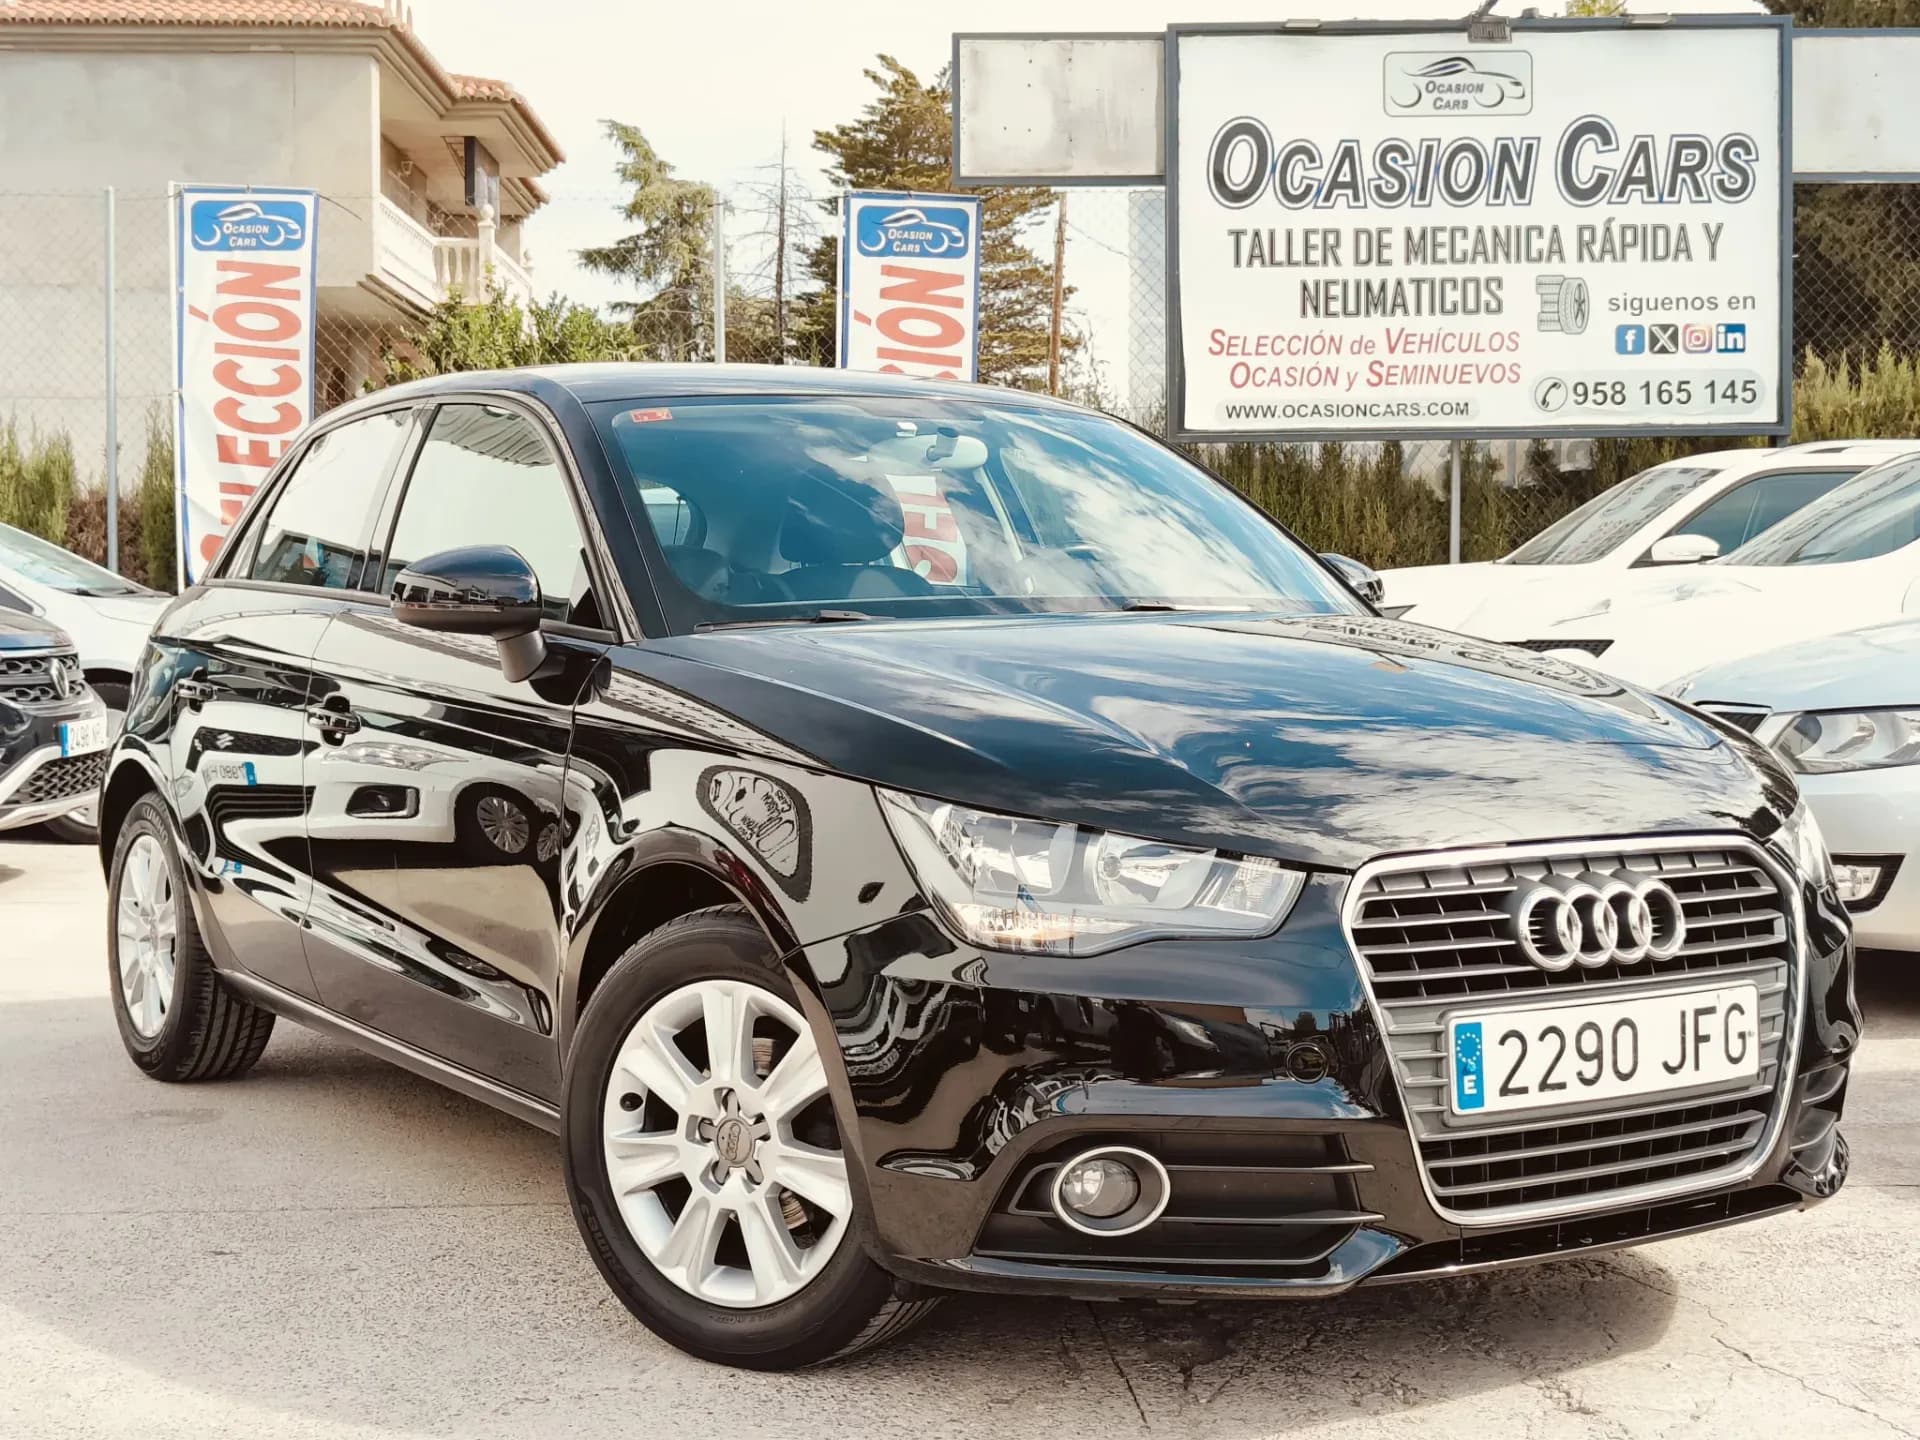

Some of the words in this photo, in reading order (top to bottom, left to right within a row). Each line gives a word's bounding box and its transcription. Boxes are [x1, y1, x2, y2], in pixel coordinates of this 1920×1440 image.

[1424, 80, 1484, 94] OCASION
[1432, 97, 1468, 110] CARS
[1207, 115, 1541, 210] OCASION
[1554, 114, 1760, 208] CARS
[223, 222, 270, 233] OCASION
[888, 228, 933, 241] OCASION
[229, 236, 256, 248] CARS
[893, 241, 921, 253] CARS
[1227, 228, 1342, 267] TALLER
[1353, 227, 1392, 266] DE
[1404, 225, 1566, 265] MECANICA
[1576, 217, 1693, 263] RÁPIDA
[1702, 223, 1724, 262] Y
[1300, 277, 1503, 318] NEUMATICOS
[1608, 293, 1719, 316] siguenos
[1728, 295, 1756, 310] en
[854, 264, 966, 380] IÓN
[1208, 329, 1343, 356] SELECCIÓN
[1350, 335, 1377, 355] de
[1385, 327, 1520, 354] VEHÍCULOS
[1229, 361, 1339, 389] OCASIÓN
[1345, 371, 1359, 392] y
[1366, 360, 1521, 387] SEMINUEVOS
[1572, 381, 1626, 406] 958
[1639, 380, 1692, 405] 165
[1704, 379, 1757, 404] 145
[188, 260, 303, 562] ECCIÓN
[1225, 402, 1470, 419] WWW.OCASIONCARS.COM
[1498, 1018, 1639, 1097] 2290
[1662, 1003, 1747, 1075] JFG
[1464, 1074, 1478, 1095] E
